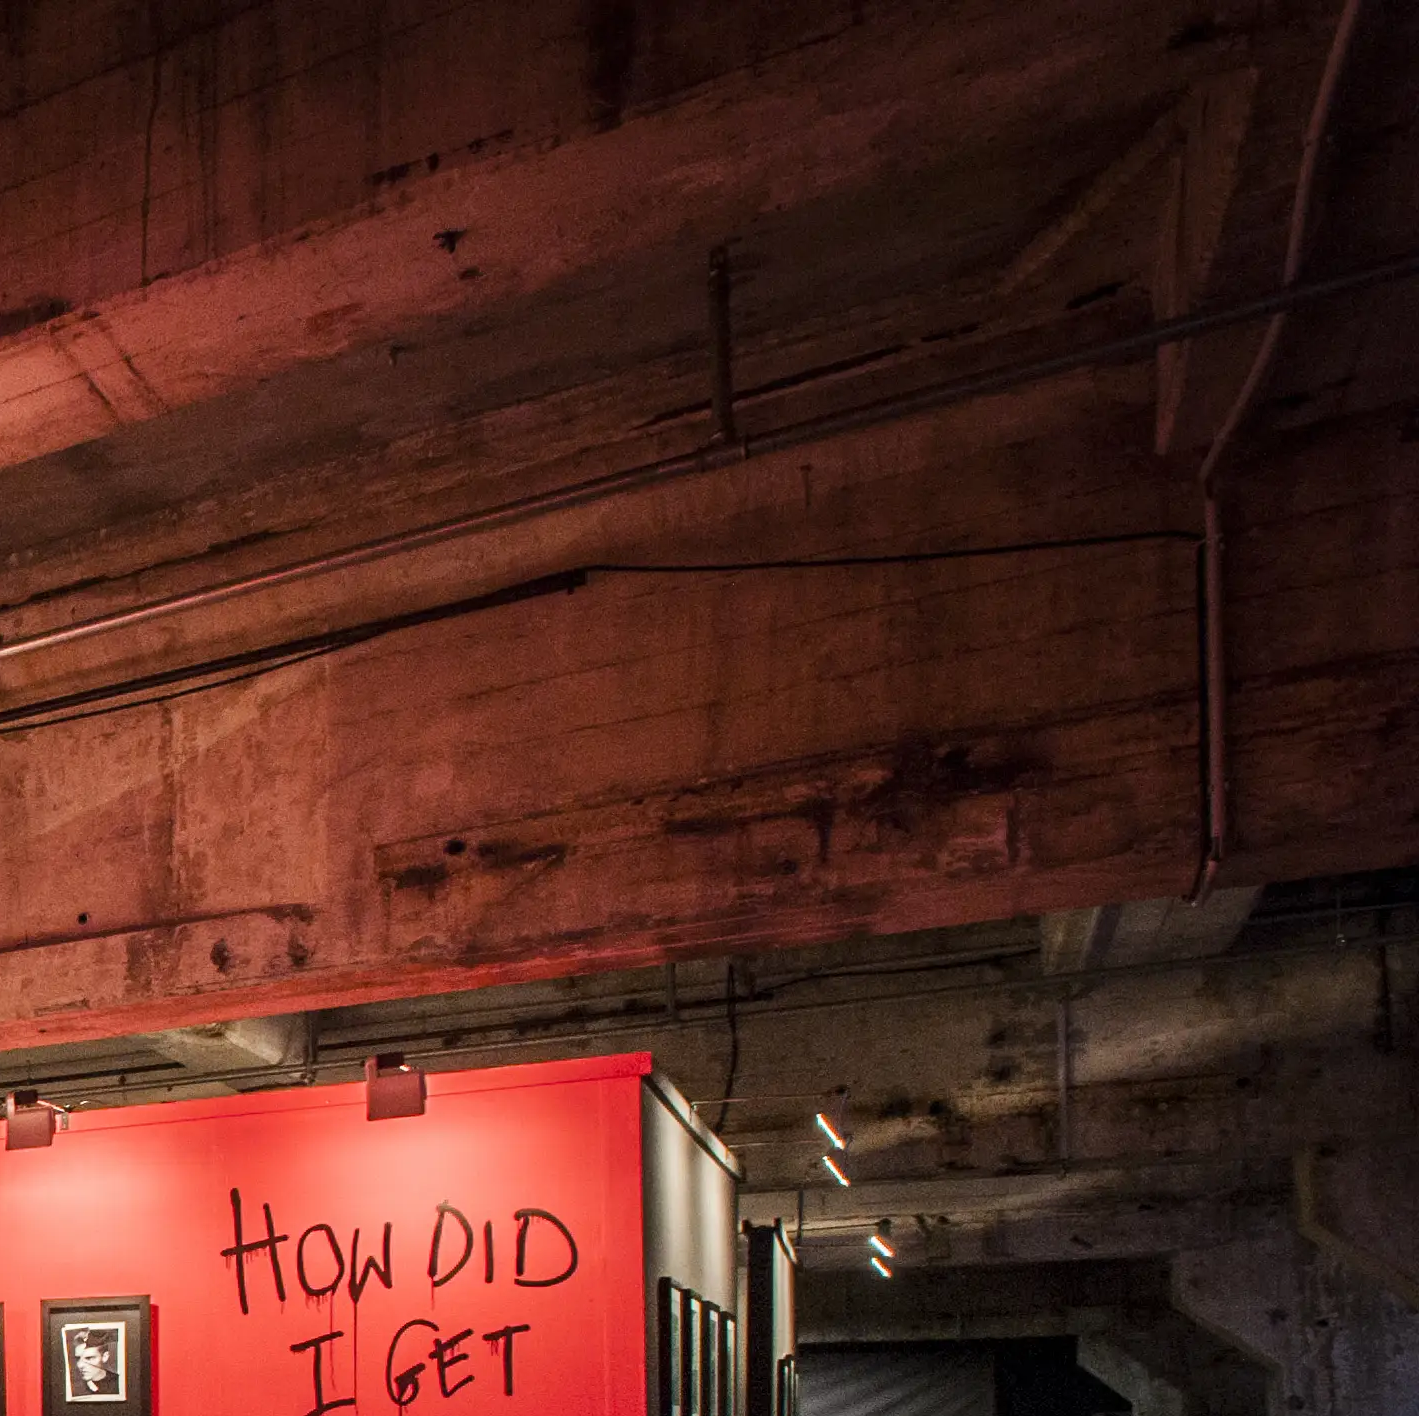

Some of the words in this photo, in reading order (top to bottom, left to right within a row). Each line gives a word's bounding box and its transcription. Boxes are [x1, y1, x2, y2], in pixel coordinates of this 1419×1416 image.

[220, 1188, 393, 1314] HOW
[429, 1202, 578, 1287] DID
[386, 1318, 530, 1407] GET
